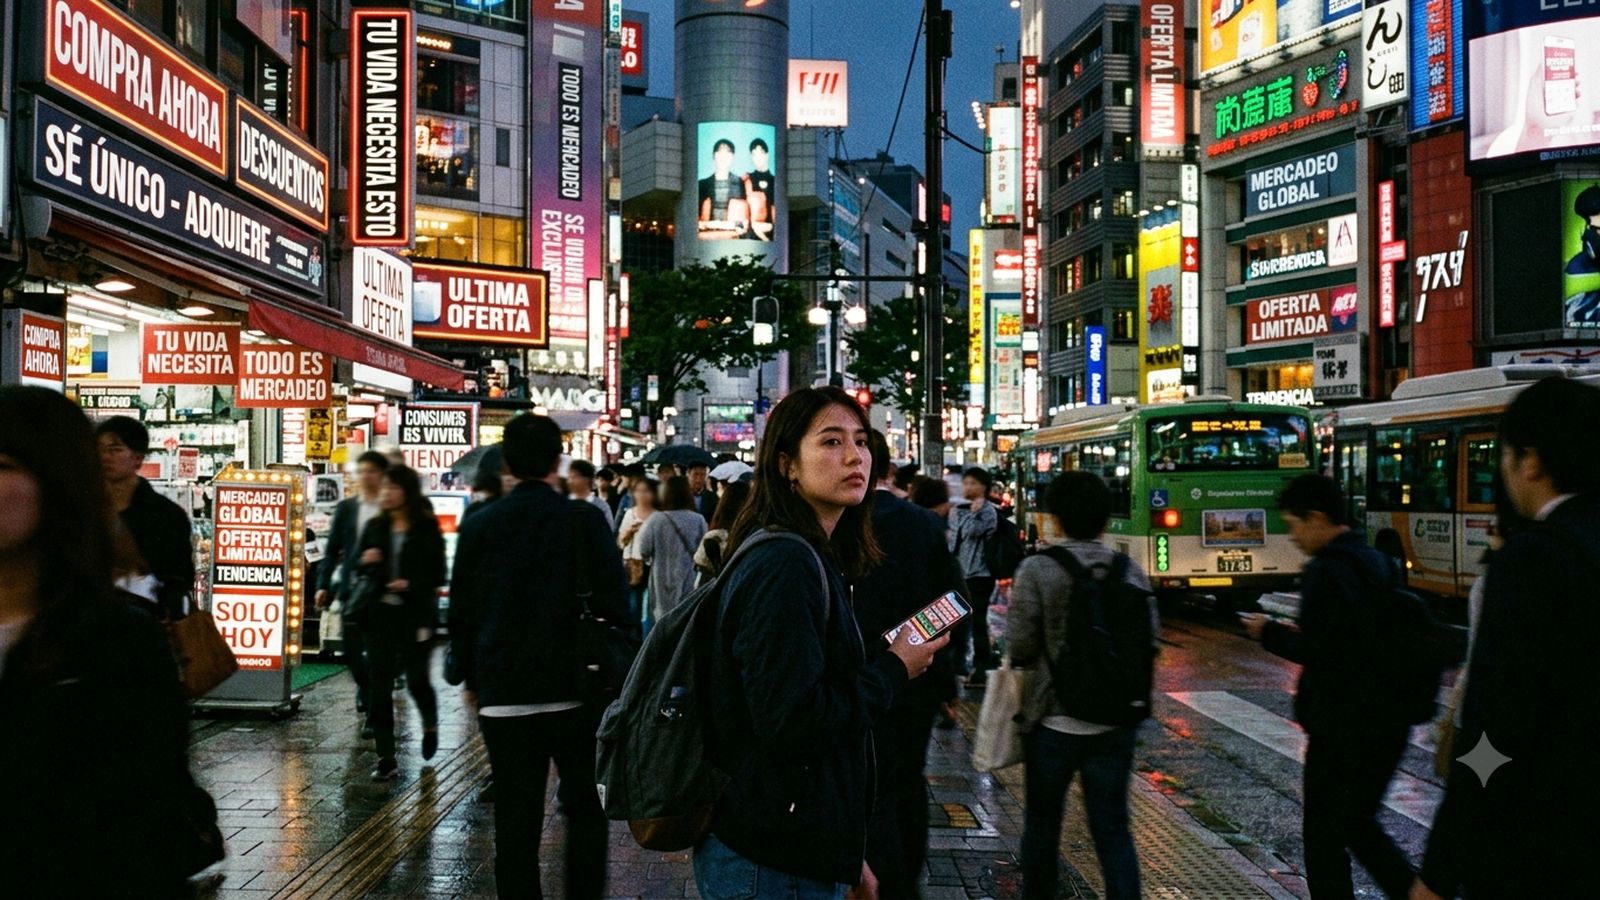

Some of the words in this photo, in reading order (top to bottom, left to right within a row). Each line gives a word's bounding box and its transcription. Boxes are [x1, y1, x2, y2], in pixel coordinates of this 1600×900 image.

[366, 19, 398, 44] TU
[1150, 4, 1175, 70] OFERTA
[54, 3, 154, 115] COMPRA
[158, 68, 221, 154] AHORA
[366, 48, 398, 94] VIDA
[562, 68, 580, 102] TODO
[562, 104, 580, 123] ES
[365, 98, 397, 186] NECESITA
[240, 120, 325, 214] DESCUENTOS
[1251, 152, 1338, 192] MERCADEO
[45, 123, 83, 186] SÉ
[90, 136, 166, 220] ÚNICO
[184, 190, 272, 265] ADQUIERE
[1258, 180, 1319, 211] GLOBAL
[365, 190, 397, 237] ESTO
[564, 213, 585, 235] SE
[362, 251, 405, 304] ULTIMA
[448, 277, 530, 307] ULTIMA
[362, 294, 405, 342] OFERTA
[447, 304, 531, 333] OFERTA
[1259, 293, 1320, 319] OFERTA
[24, 323, 61, 351] COMPRA
[1252, 314, 1328, 341] LIMITADA
[153, 330, 180, 351] TU
[183, 331, 229, 352] VIDA
[24, 352, 60, 376] AHORA
[147, 353, 235, 375] NECESITA
[243, 350, 295, 375] TODO
[300, 351, 324, 376] ES
[240, 378, 327, 401] MERCADEO
[219, 490, 286, 506] MERCADEO
[219, 505, 285, 525] GLOBAL
[218, 529, 283, 548] OFERTA
[218, 547, 283, 562] LIMITADA
[216, 566, 283, 583] TENDENCIA
[216, 601, 280, 623] SOLO
[221, 626, 274, 649] HOY
